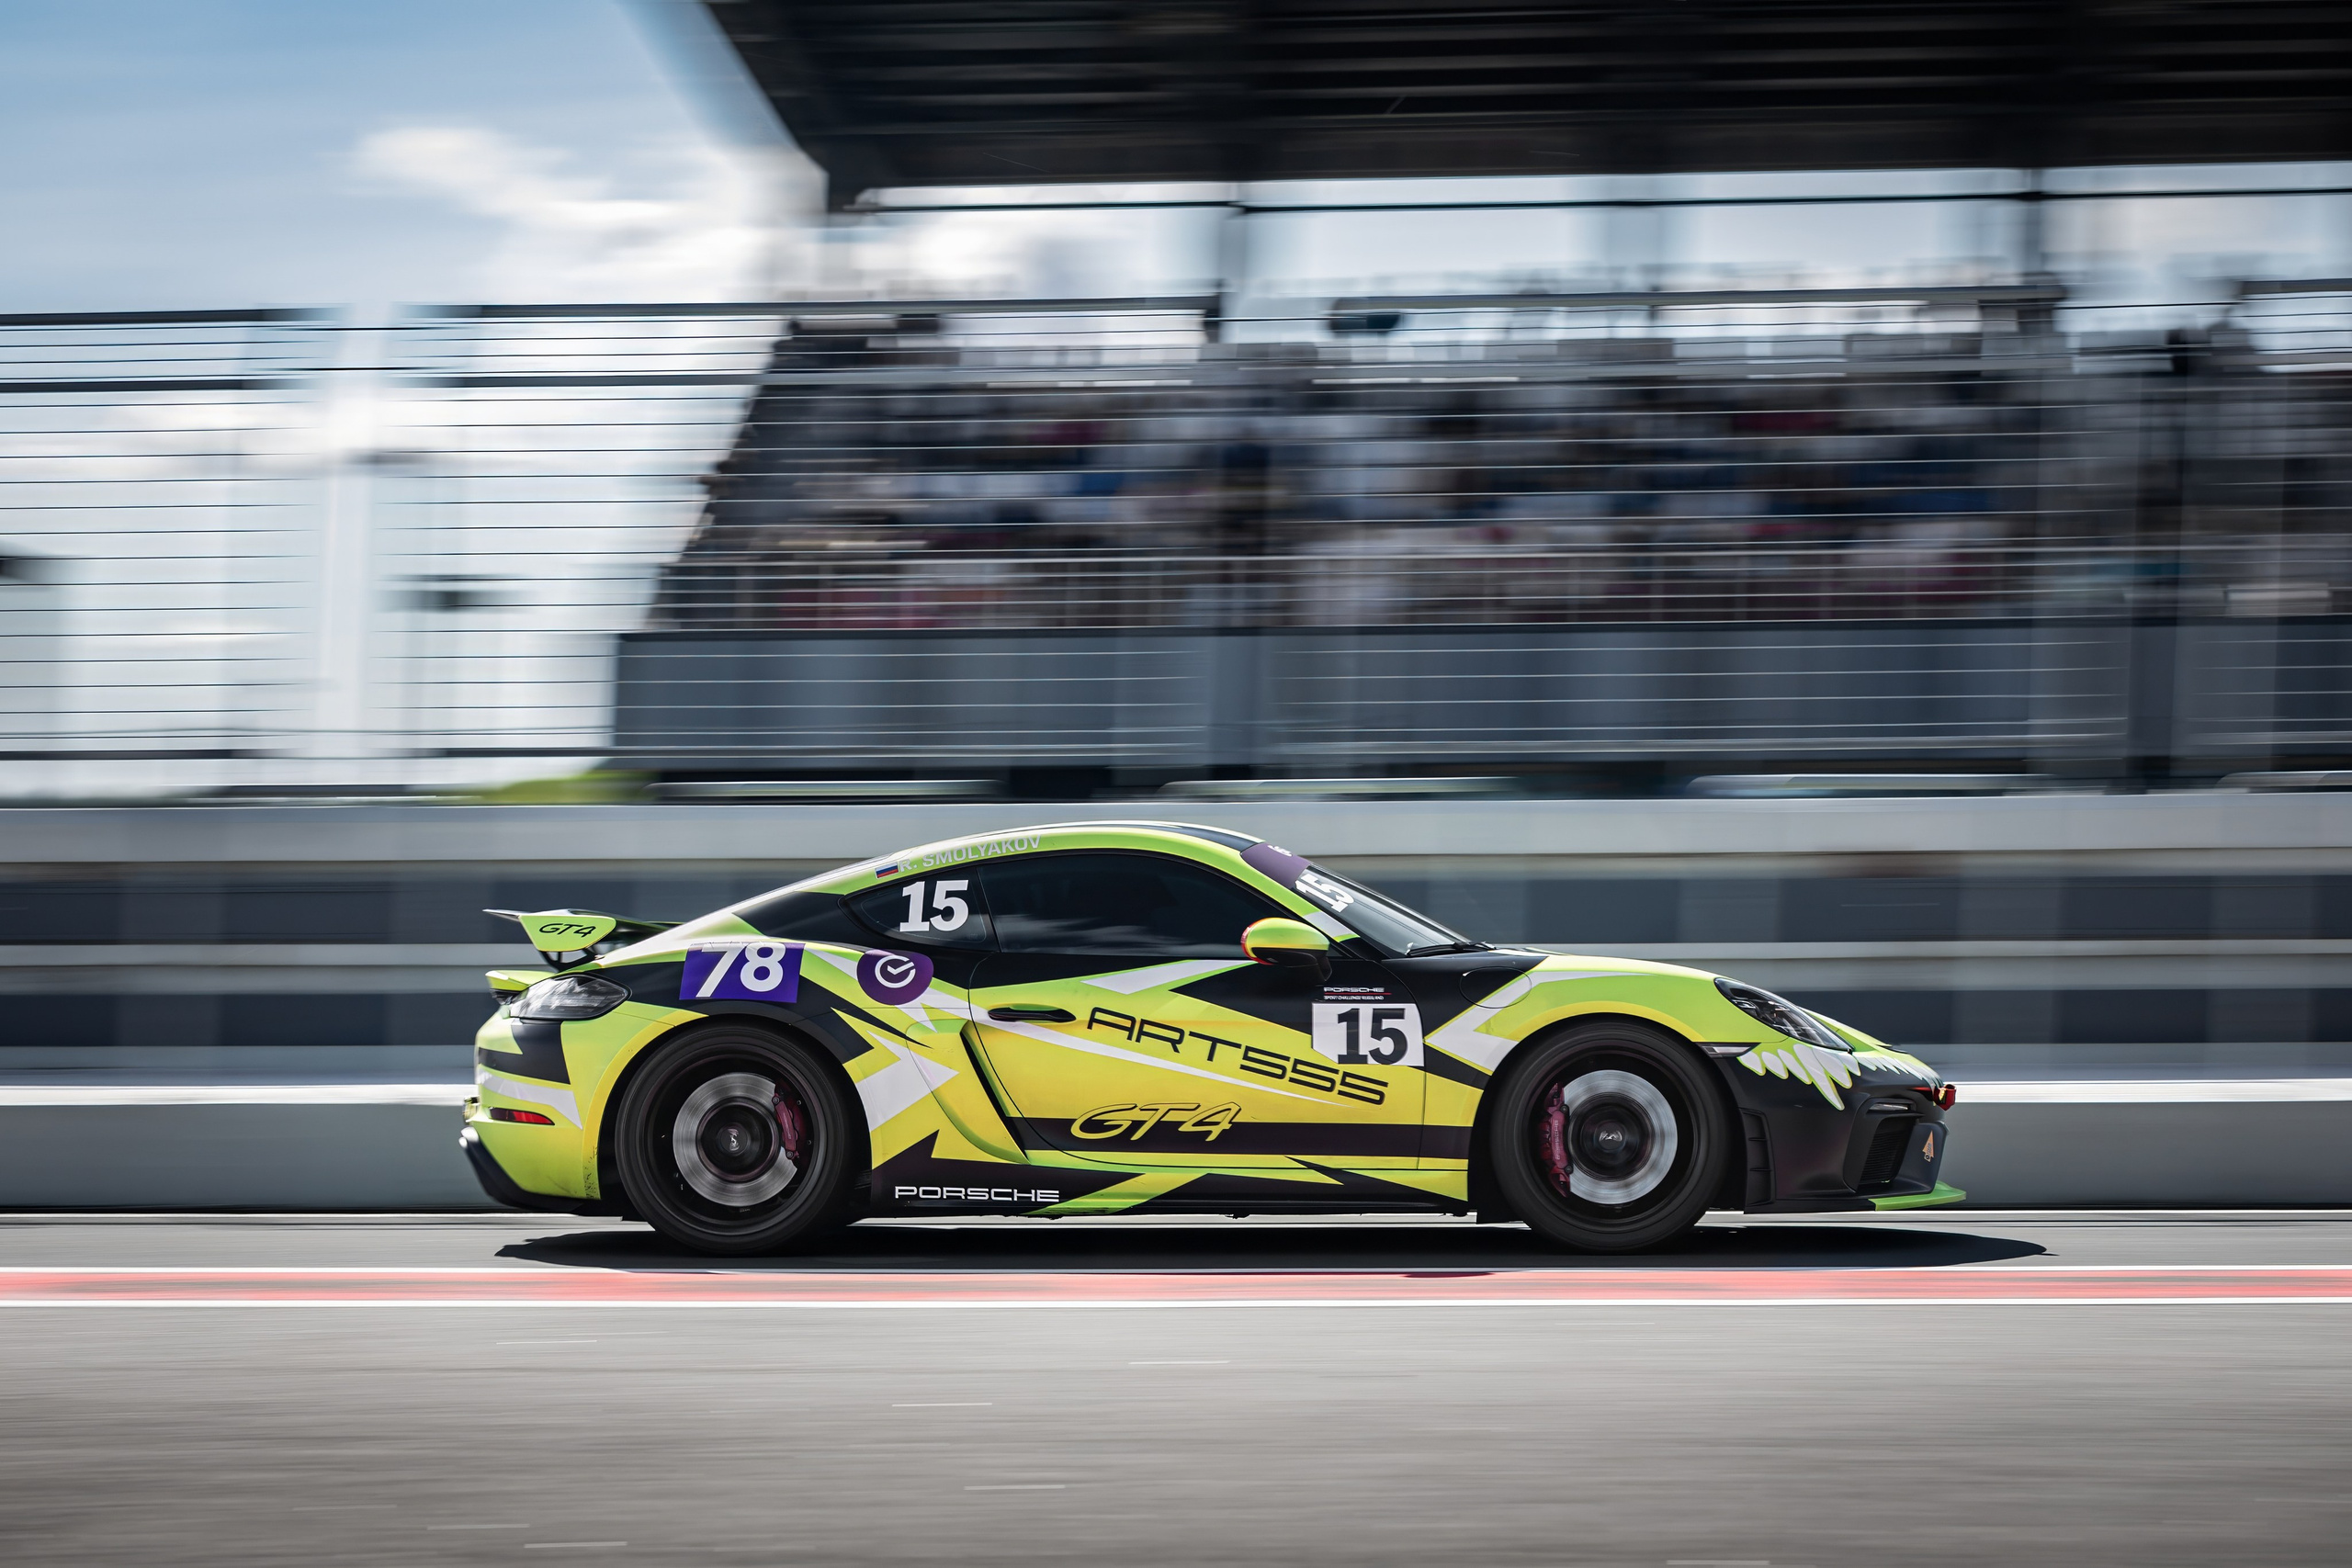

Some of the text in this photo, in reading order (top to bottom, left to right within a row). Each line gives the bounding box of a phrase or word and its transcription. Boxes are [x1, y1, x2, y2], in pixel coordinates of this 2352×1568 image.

[899, 835, 1041, 873] R. SMOLYAKOV
[899, 879, 969, 931] 15
[1295, 873, 1355, 913] 15
[539, 922, 596, 938] GT4
[695, 941, 786, 998] 78
[1086, 1006, 1389, 1106] ART555
[1337, 1008, 1408, 1066] 15
[1070, 1101, 1242, 1142] GT4
[894, 1185, 1059, 1203] PORSCHE
